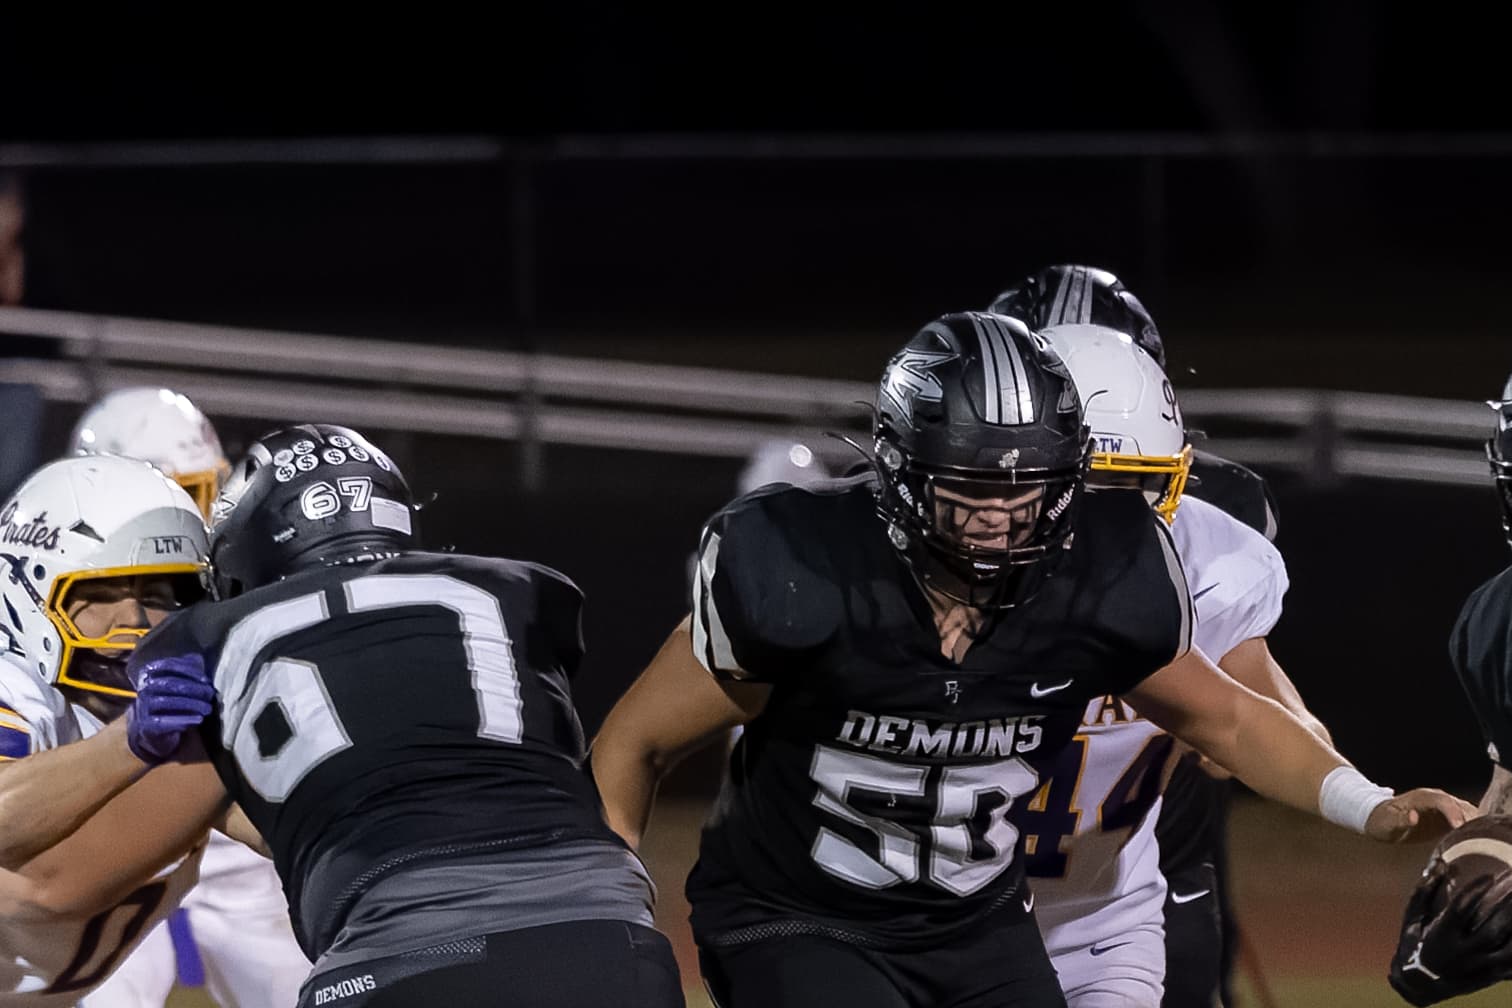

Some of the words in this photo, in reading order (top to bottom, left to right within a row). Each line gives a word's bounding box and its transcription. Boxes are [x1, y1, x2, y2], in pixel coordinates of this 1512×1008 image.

[1096, 438, 1122, 453] TW
[301, 476, 373, 520] 67
[155, 538, 183, 554] LTW
[213, 574, 524, 803] 67
[835, 709, 1048, 757] DEMONS
[315, 974, 377, 1006] DEMONS
